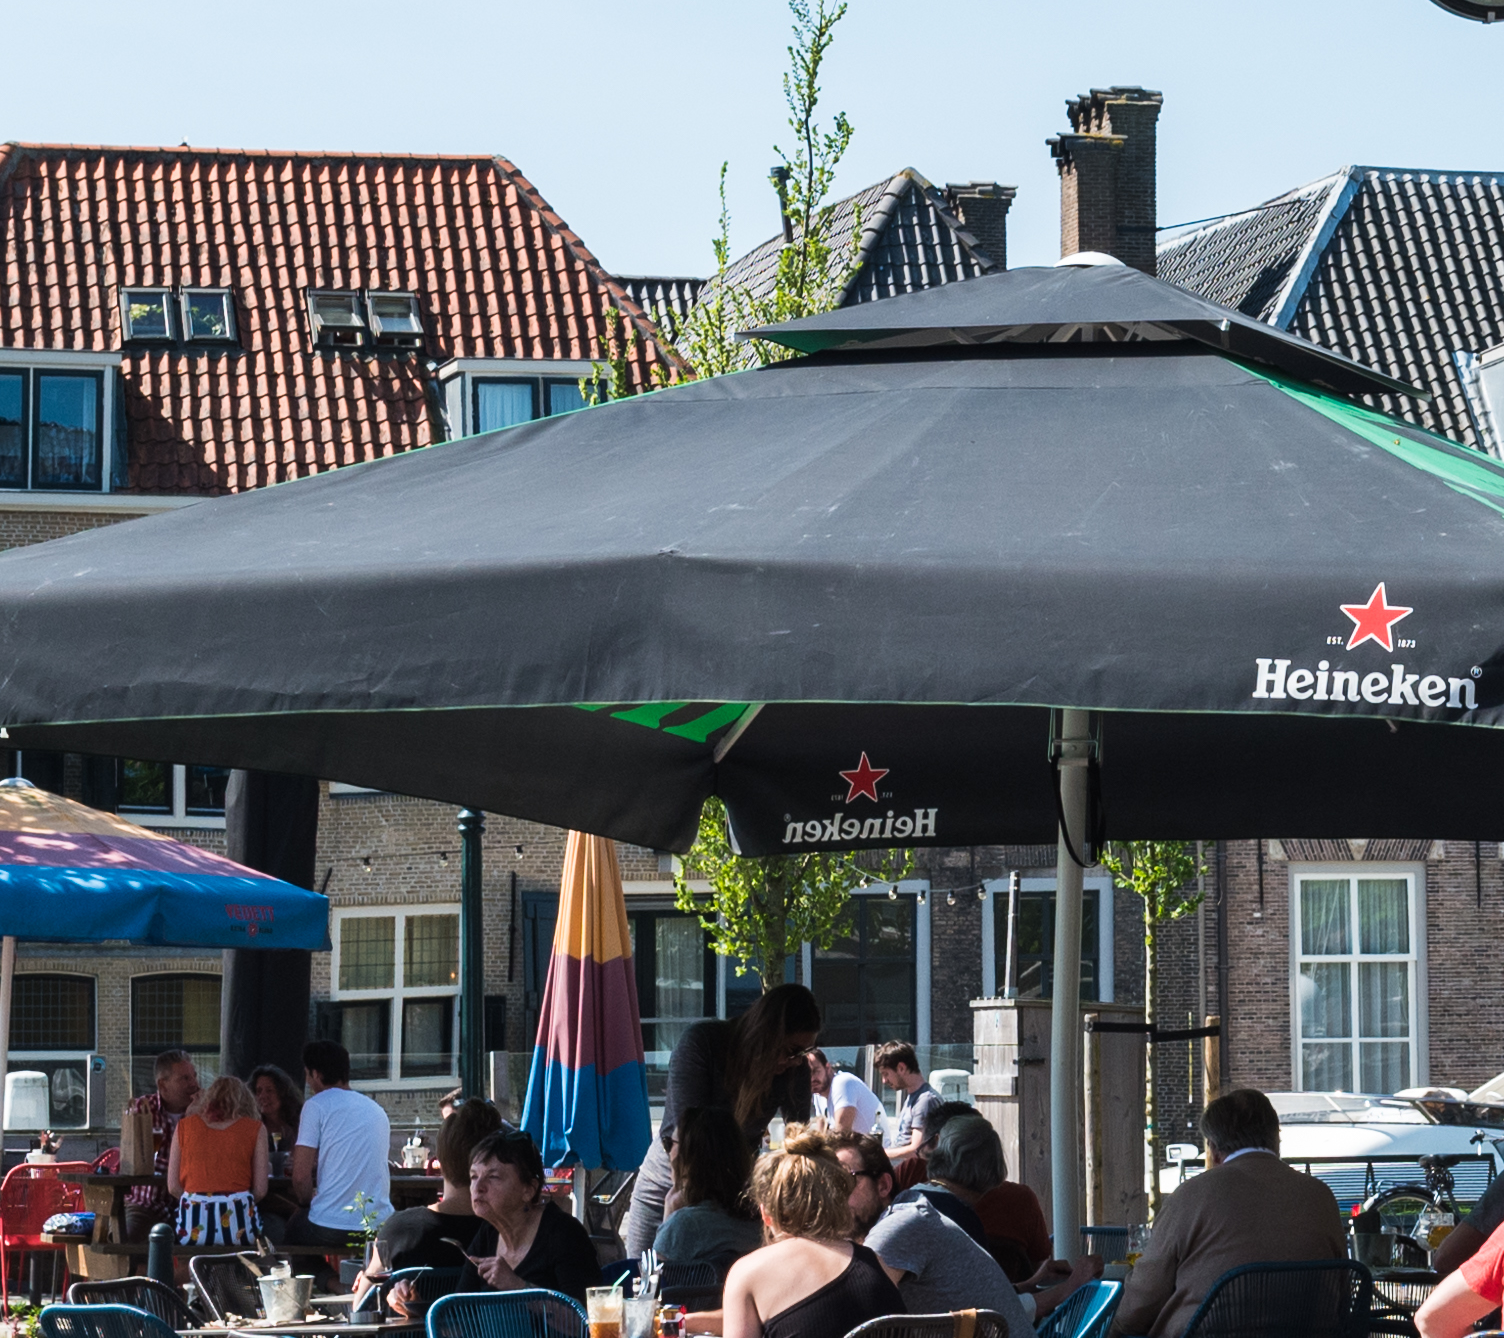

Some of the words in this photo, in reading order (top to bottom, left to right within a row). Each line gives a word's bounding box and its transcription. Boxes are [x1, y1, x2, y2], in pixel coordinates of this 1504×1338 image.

[1397, 638, 1417, 649] 1873
[1252, 657, 1479, 710] Heineken
[224, 903, 274, 922] VEDETT
